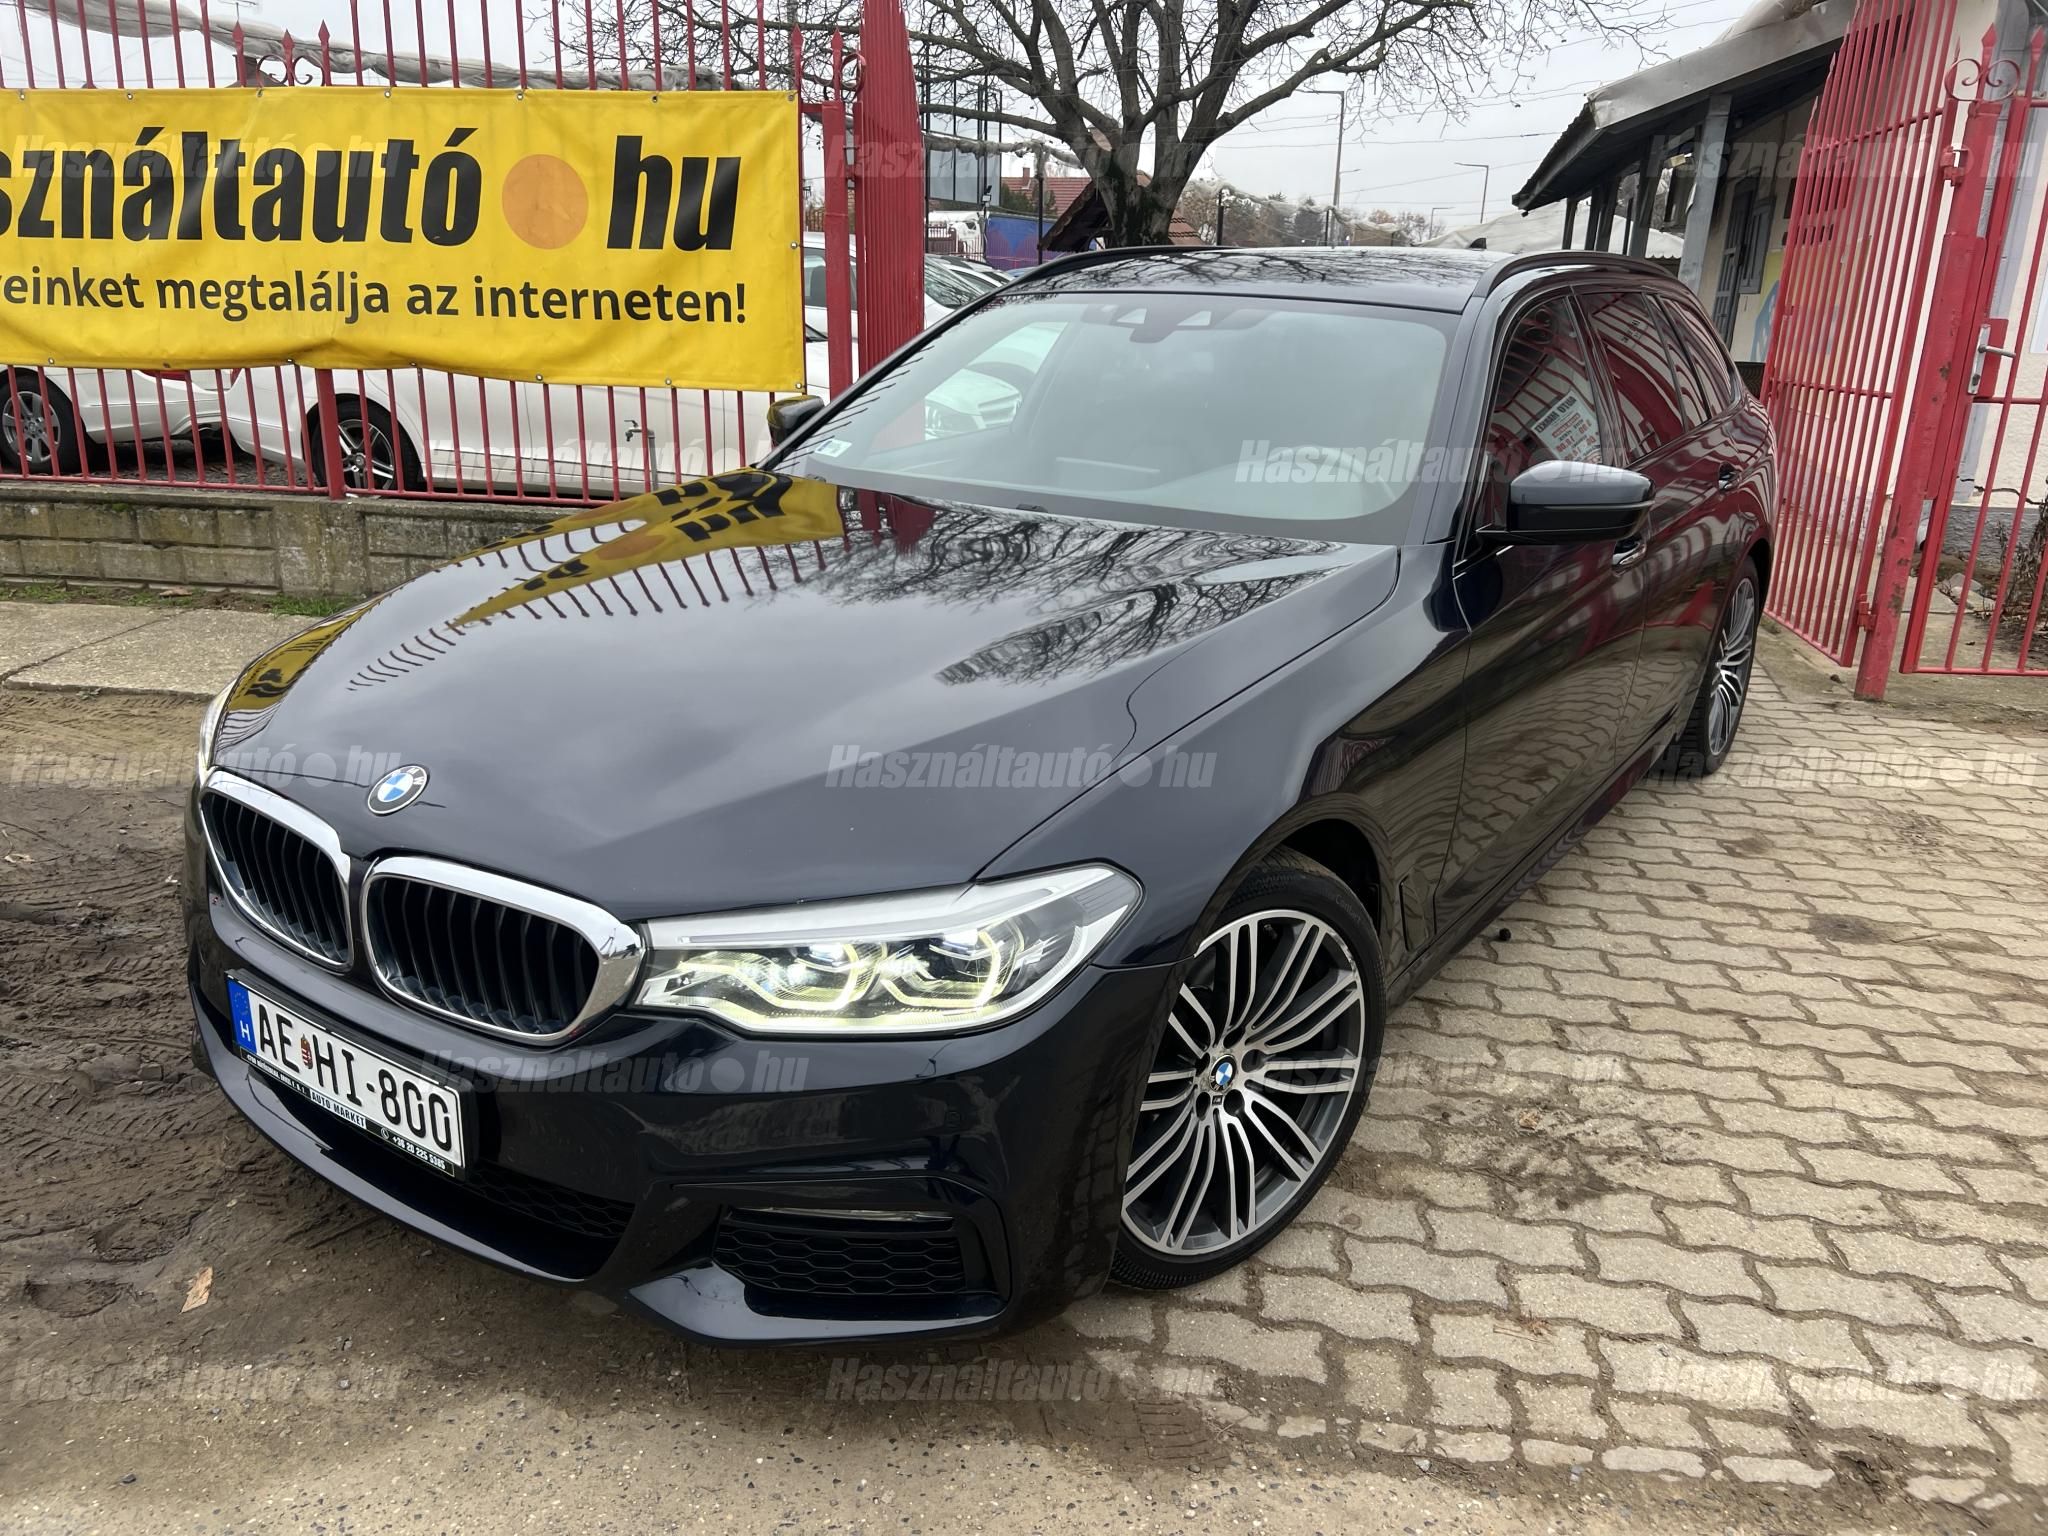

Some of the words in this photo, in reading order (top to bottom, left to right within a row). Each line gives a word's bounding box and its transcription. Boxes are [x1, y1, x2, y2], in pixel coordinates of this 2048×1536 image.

[607, 135, 741, 250] hu
[0, 267, 144, 308] einket
[157, 270, 389, 324] megtalálja
[406, 283, 459, 316] az
[474, 275, 746, 323] interneten!
[240, 1020, 251, 1042] H
[258, 1003, 300, 1073] AE
[312, 1034, 452, 1152] HI-800
[312, 1091, 331, 1109] AUTO
[333, 1104, 366, 1127] MARKET
